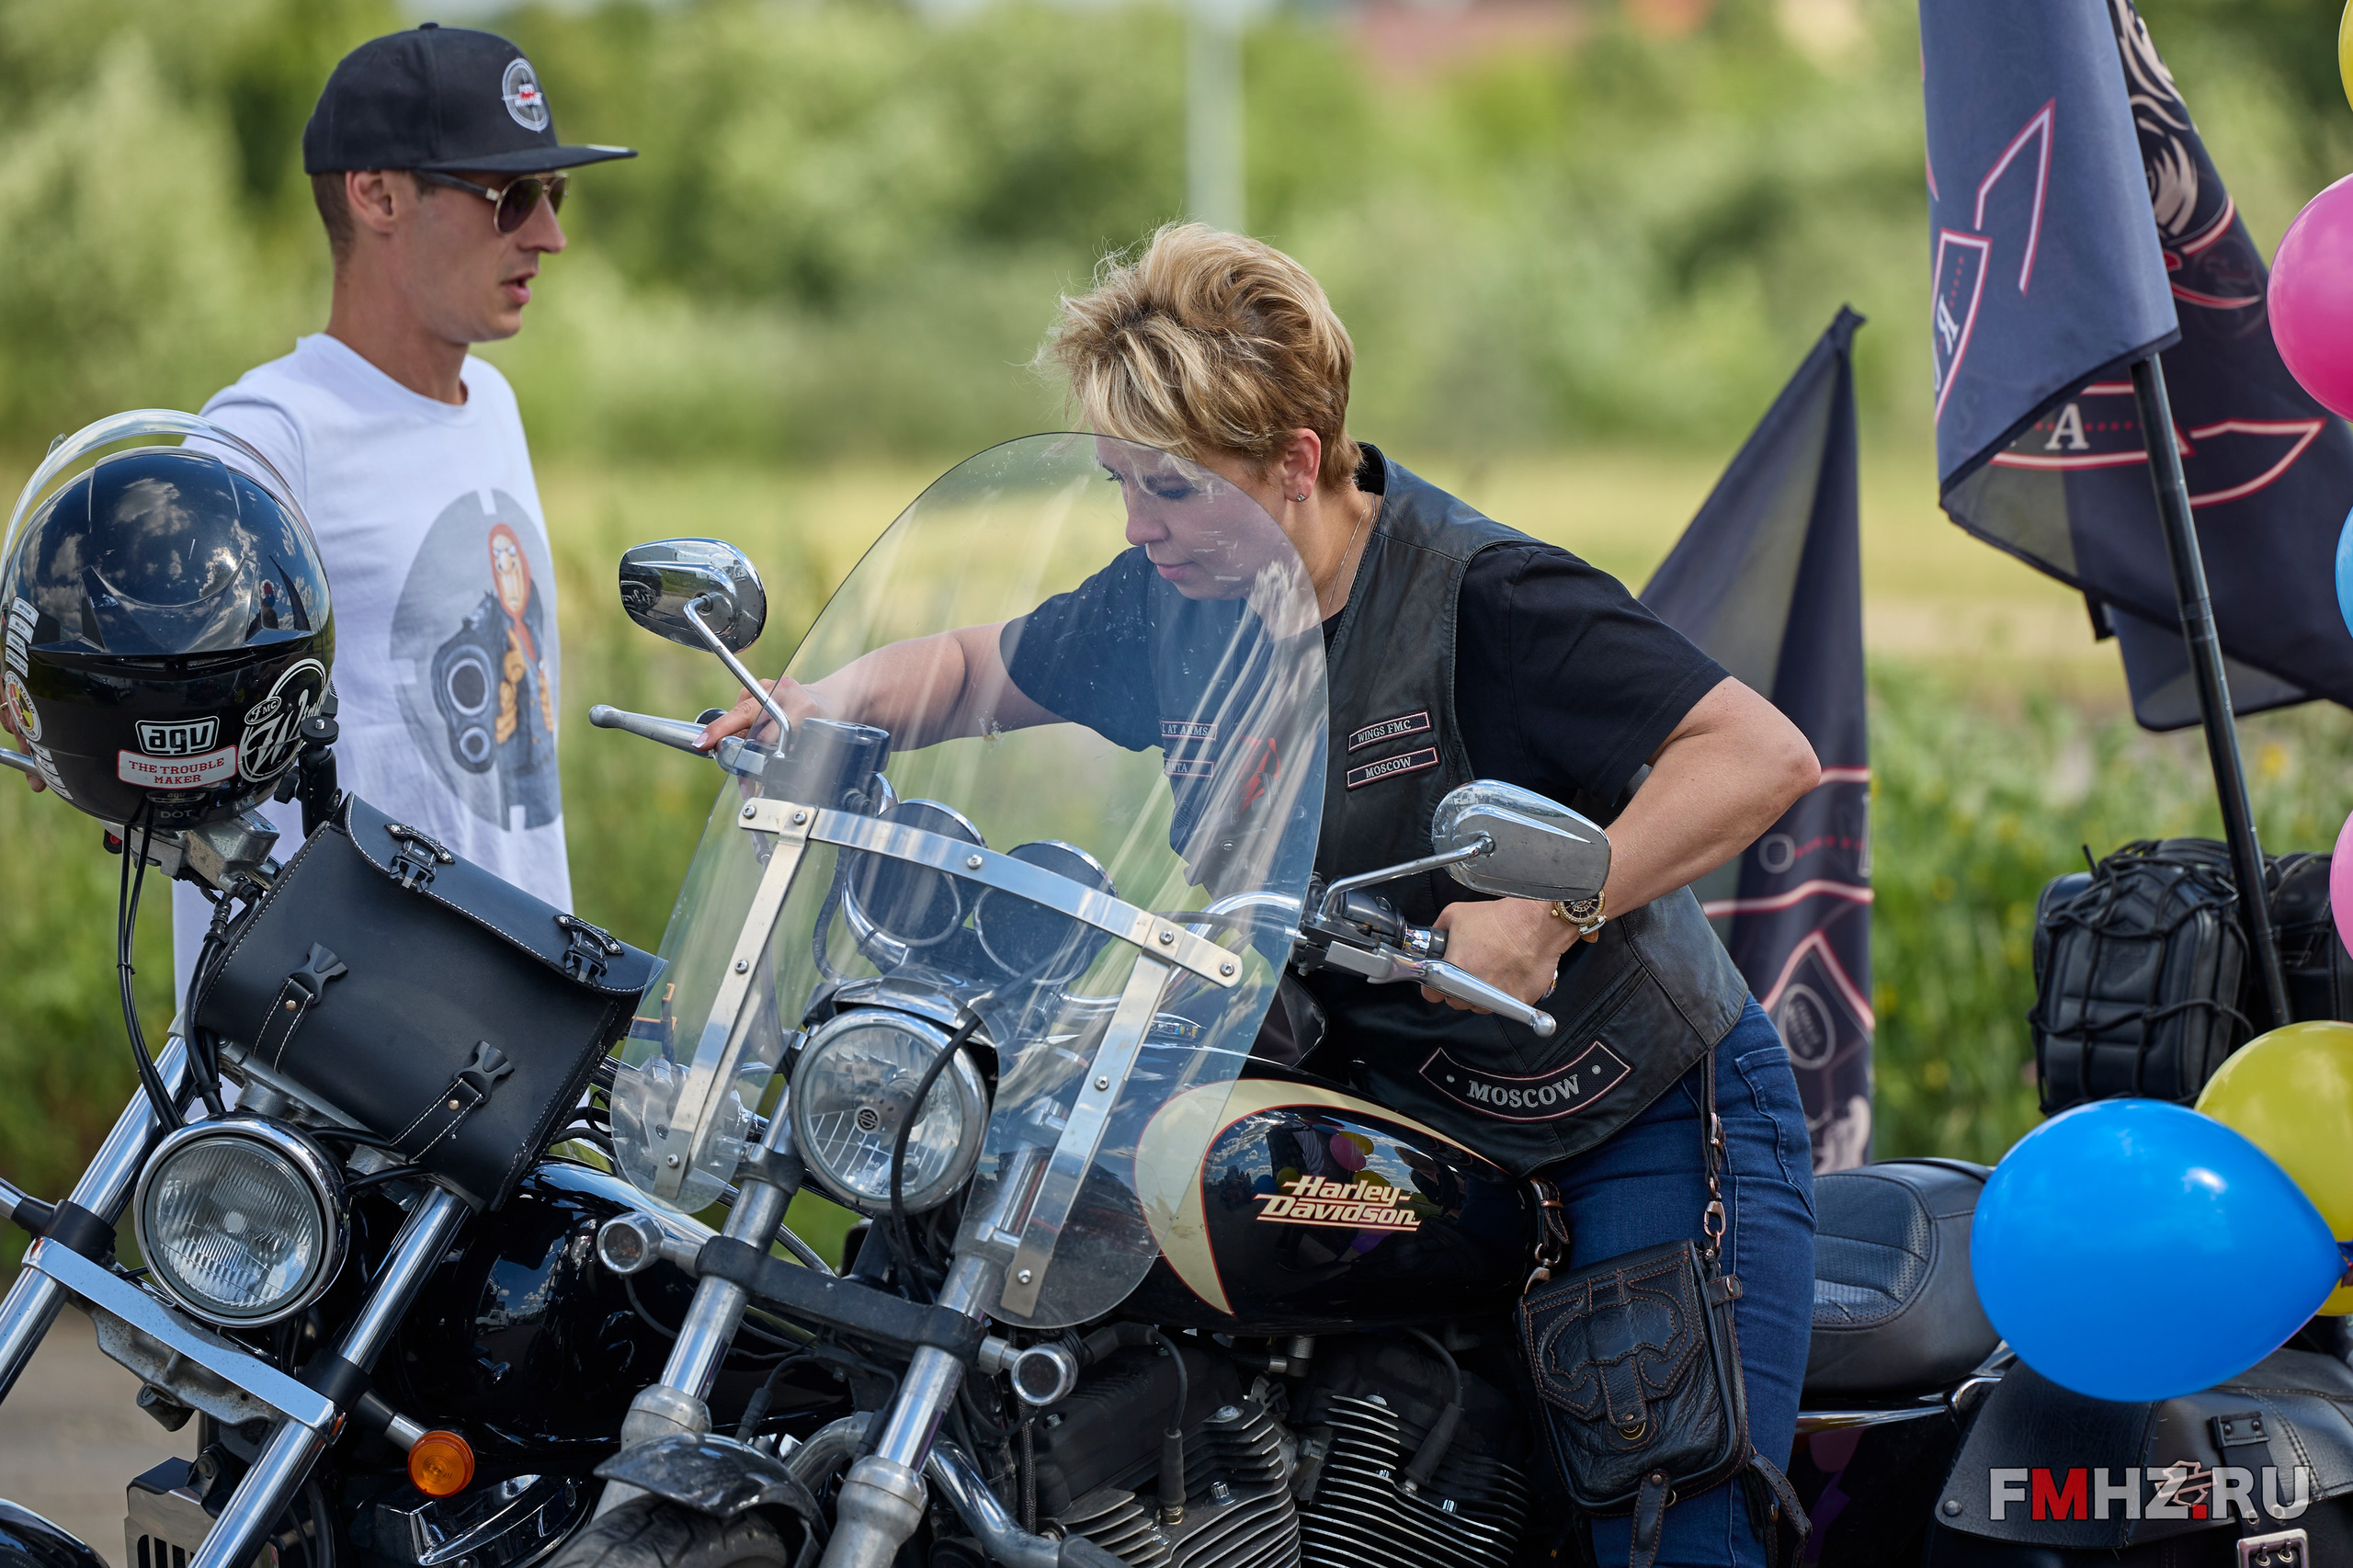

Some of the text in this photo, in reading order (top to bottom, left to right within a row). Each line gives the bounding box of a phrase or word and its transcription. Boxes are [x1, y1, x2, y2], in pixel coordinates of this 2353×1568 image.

[147, 724, 210, 754] agv
[1167, 725, 1177, 733] AT
[1179, 725, 1208, 736] ARMS
[1358, 720, 1411, 743] WINGS FMC
[129, 757, 224, 774] THE TROUBLE
[1364, 756, 1411, 778] MOSCOW
[154, 774, 201, 784] MAKER
[160, 810, 192, 819] DOT
[1466, 1074, 1580, 1108] MOSCOW
[1253, 1194, 1422, 1226] Davidson
